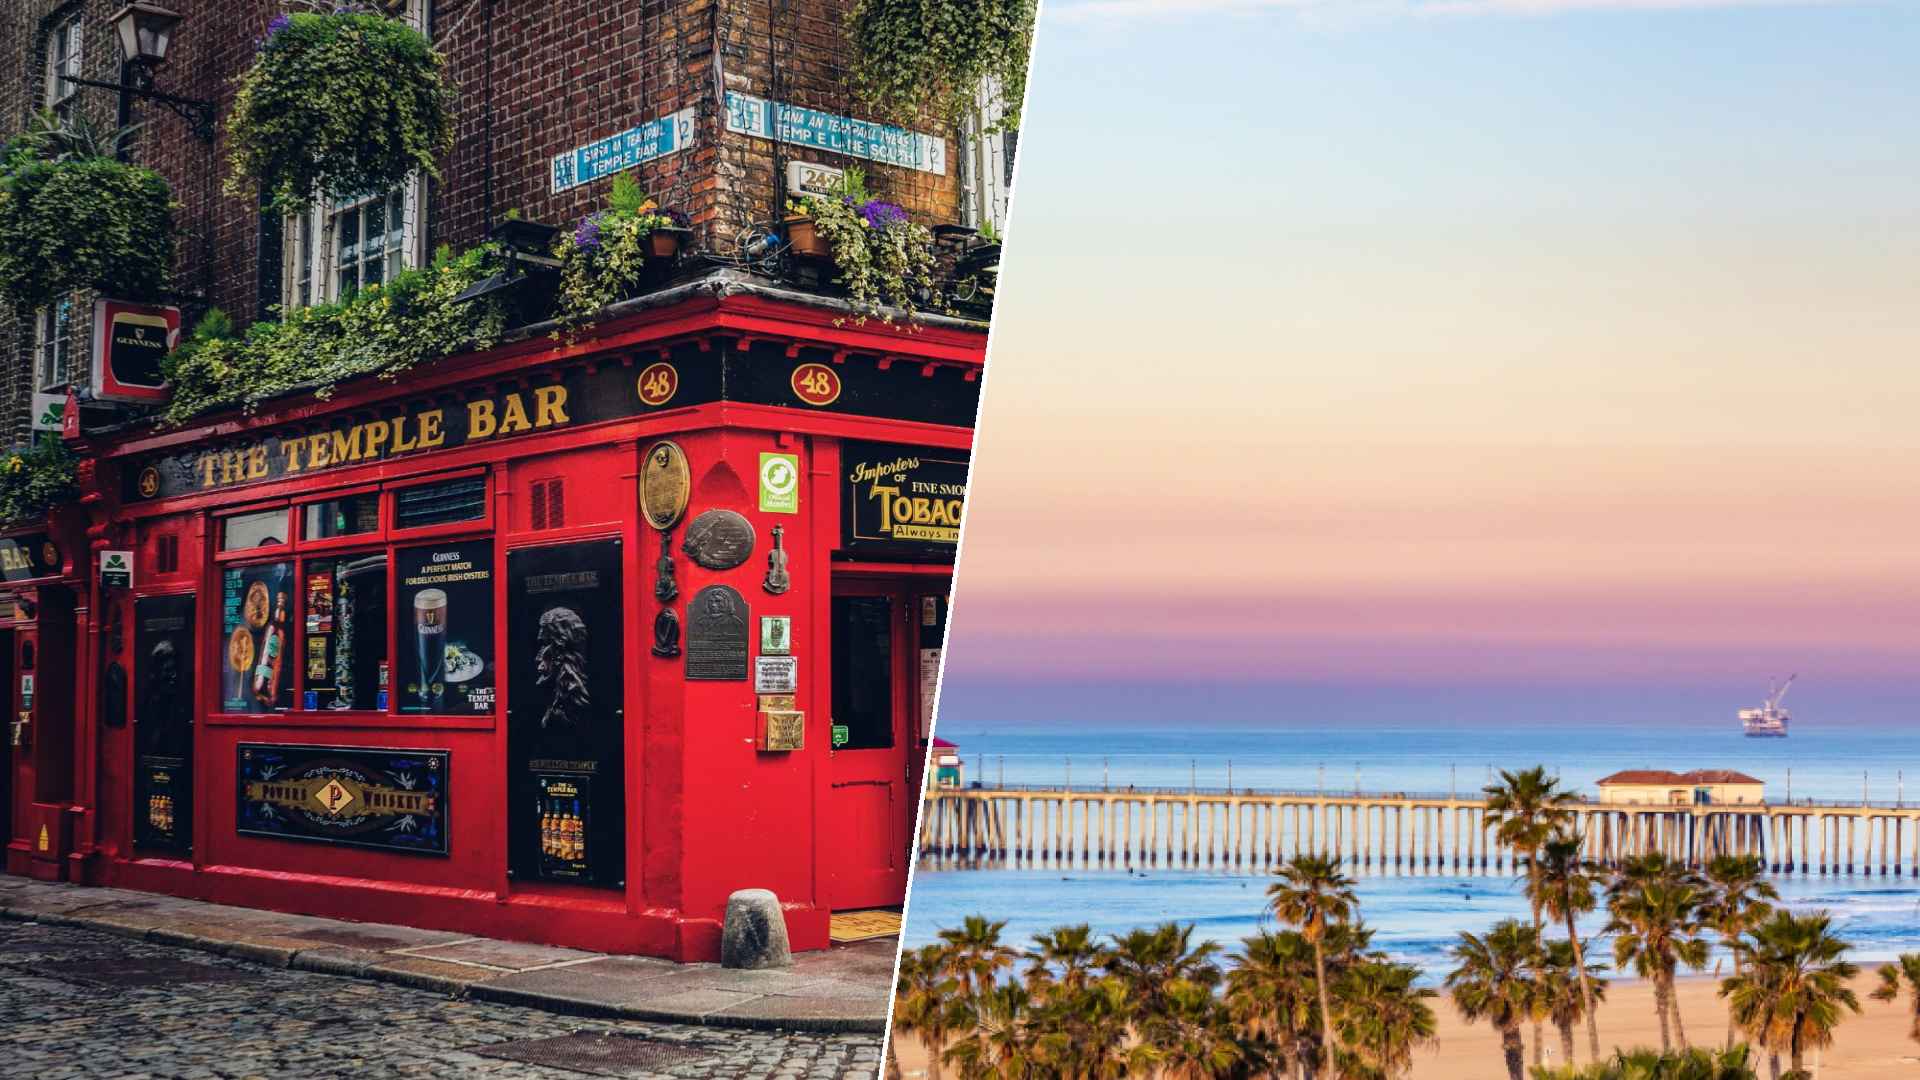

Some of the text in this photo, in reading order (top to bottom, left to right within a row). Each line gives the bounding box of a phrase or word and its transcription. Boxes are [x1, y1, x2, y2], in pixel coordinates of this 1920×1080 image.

[808, 115, 824, 129] AN
[777, 124, 826, 145] TEMPE
[592, 151, 632, 175] TEMPLE
[116, 337, 163, 349] GUINNESS
[643, 370, 671, 398] 48
[800, 368, 831, 396] 48
[199, 384, 570, 487] THE TEMPLE BAR
[850, 456, 920, 487] Importers
[893, 474, 907, 483] OF
[912, 481, 938, 495] FINE
[895, 525, 959, 540] Always in
[0, 545, 34, 571] BAR
[467, 694, 496, 702] TEMPLE
[474, 702, 489, 710] BAR
